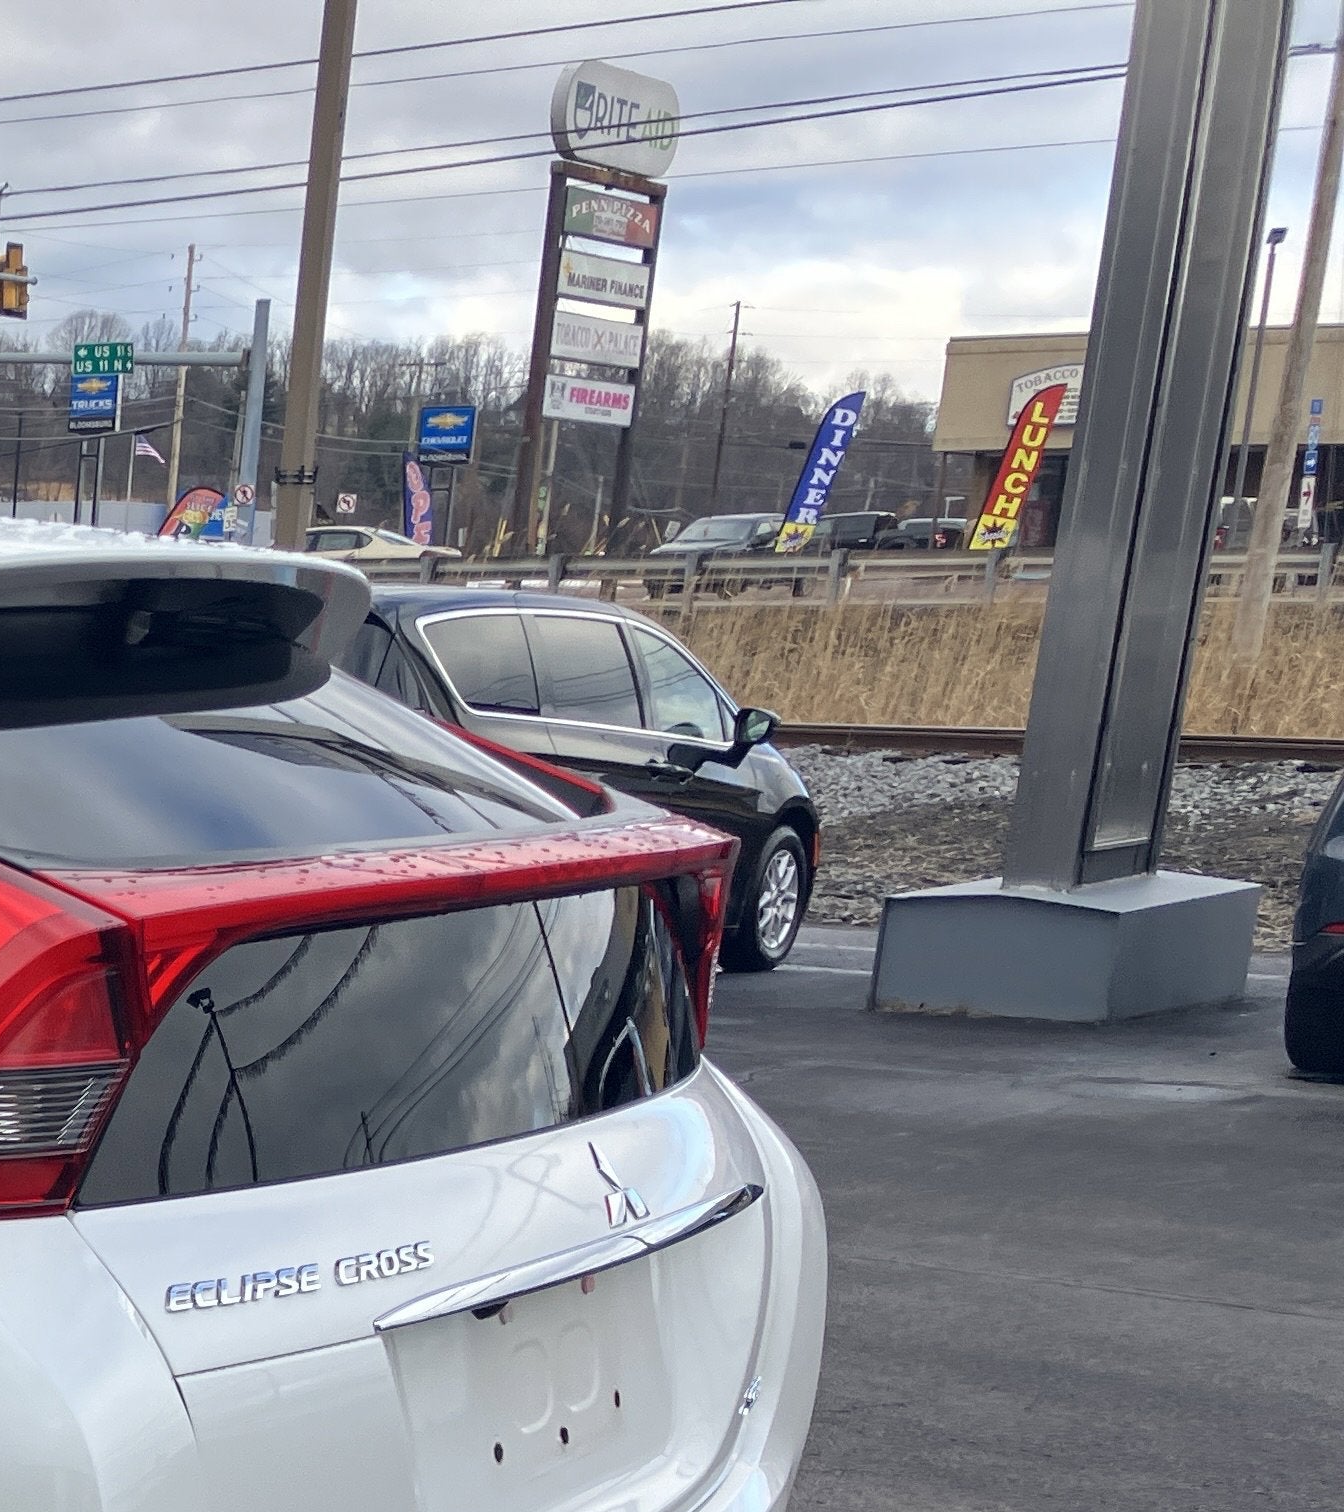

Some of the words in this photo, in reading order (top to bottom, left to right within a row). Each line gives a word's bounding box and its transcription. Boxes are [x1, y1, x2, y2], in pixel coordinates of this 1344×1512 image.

[594, 91, 640, 142] RITE
[641, 107, 675, 150] AID
[571, 198, 609, 218] PENN
[613, 199, 650, 233] PIZZA
[567, 272, 607, 293] MARINER
[610, 280, 644, 300] FINANCE
[94, 345, 110, 358] US
[116, 345, 125, 357] 11
[557, 322, 591, 349] TOBACCO
[607, 331, 639, 355] PALACE
[76, 360, 92, 373] US
[99, 360, 109, 372] 11
[113, 359, 123, 371] N
[1016, 367, 1079, 393] TOBACCO
[72, 400, 113, 410] TRUCKS
[569, 386, 630, 410] FIREARMS
[420, 435, 468, 445] CHEVROLET
[794, 407, 857, 524] DINNER
[992, 401, 1049, 518] LUNCH
[165, 1263, 322, 1313] ECLIPSE
[334, 1240, 435, 1286] CROSS
